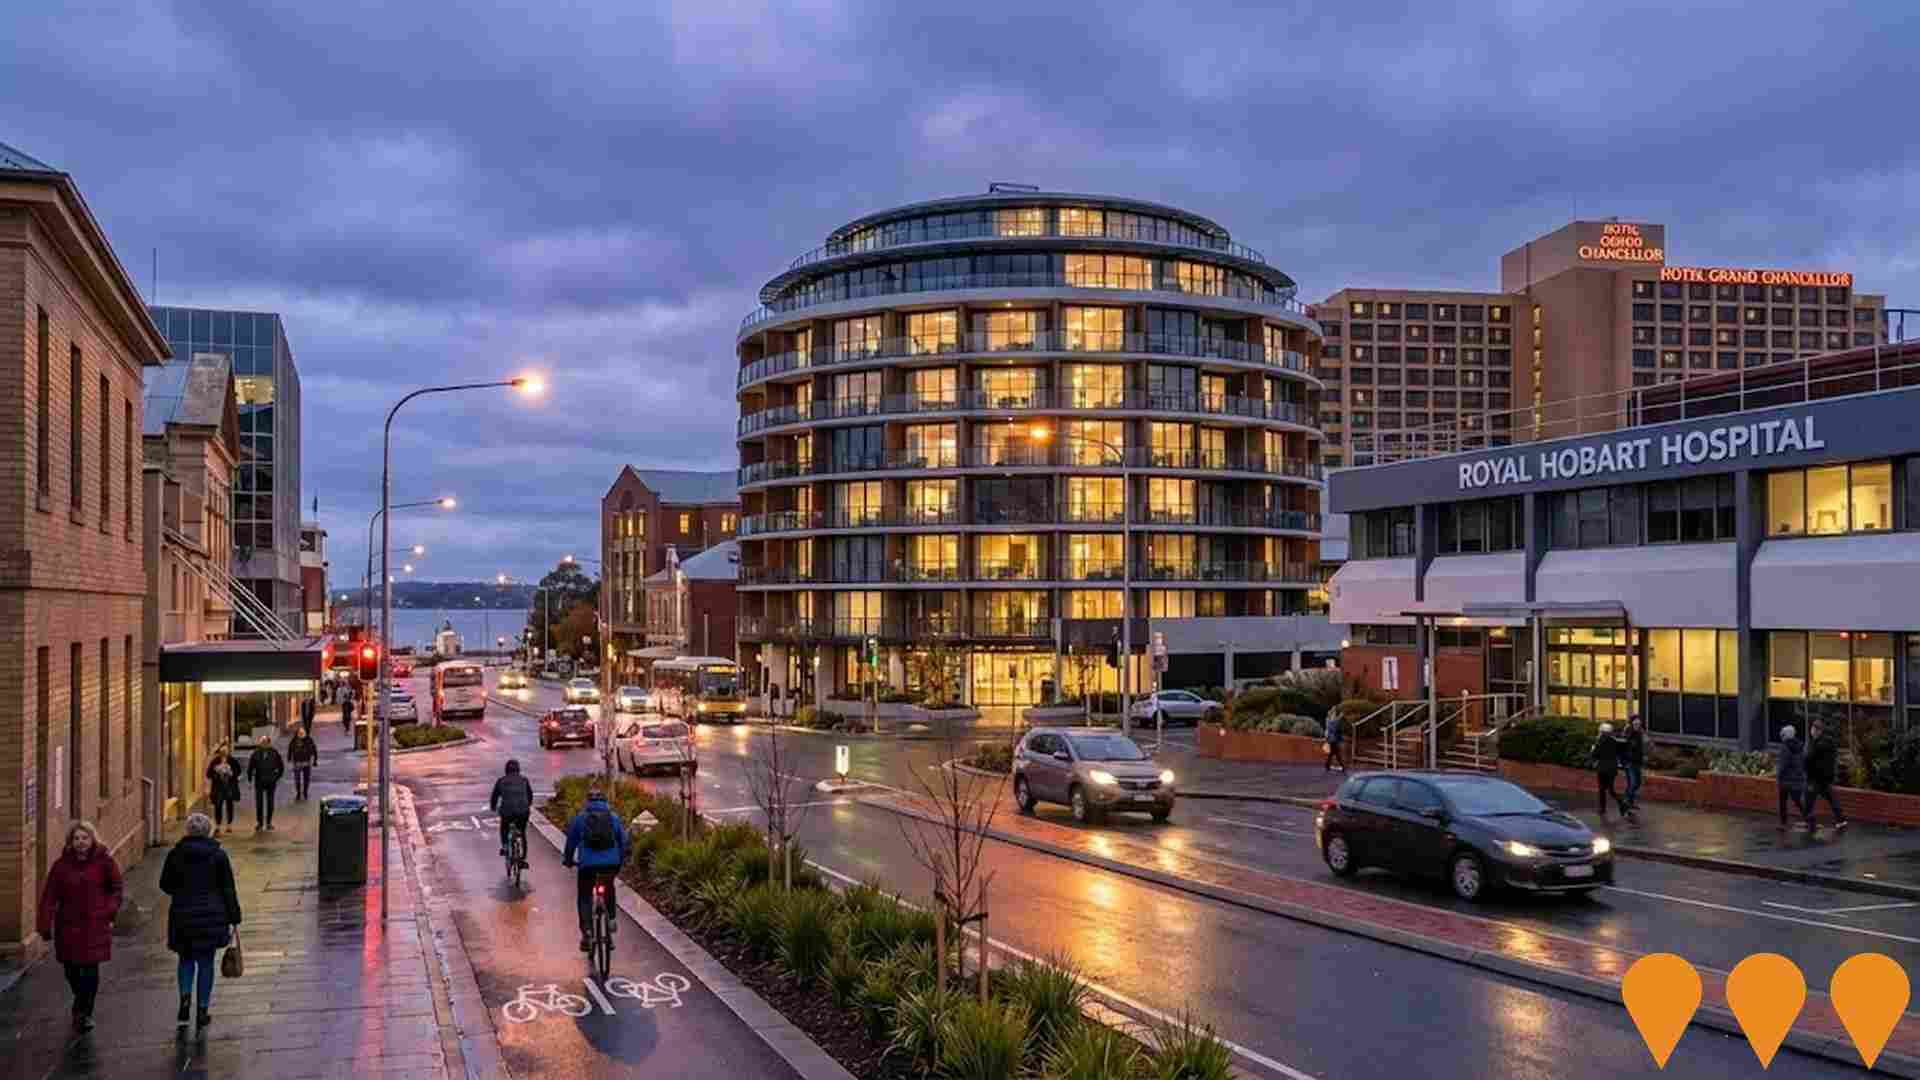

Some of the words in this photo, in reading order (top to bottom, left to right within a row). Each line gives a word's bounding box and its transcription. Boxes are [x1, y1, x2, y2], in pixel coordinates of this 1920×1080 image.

[1708, 269, 1757, 284] GRAND
[1459, 455, 1532, 489] ROYAL
[1540, 439, 1651, 480] HOBART
[1661, 416, 1825, 466] HOSPITAL
